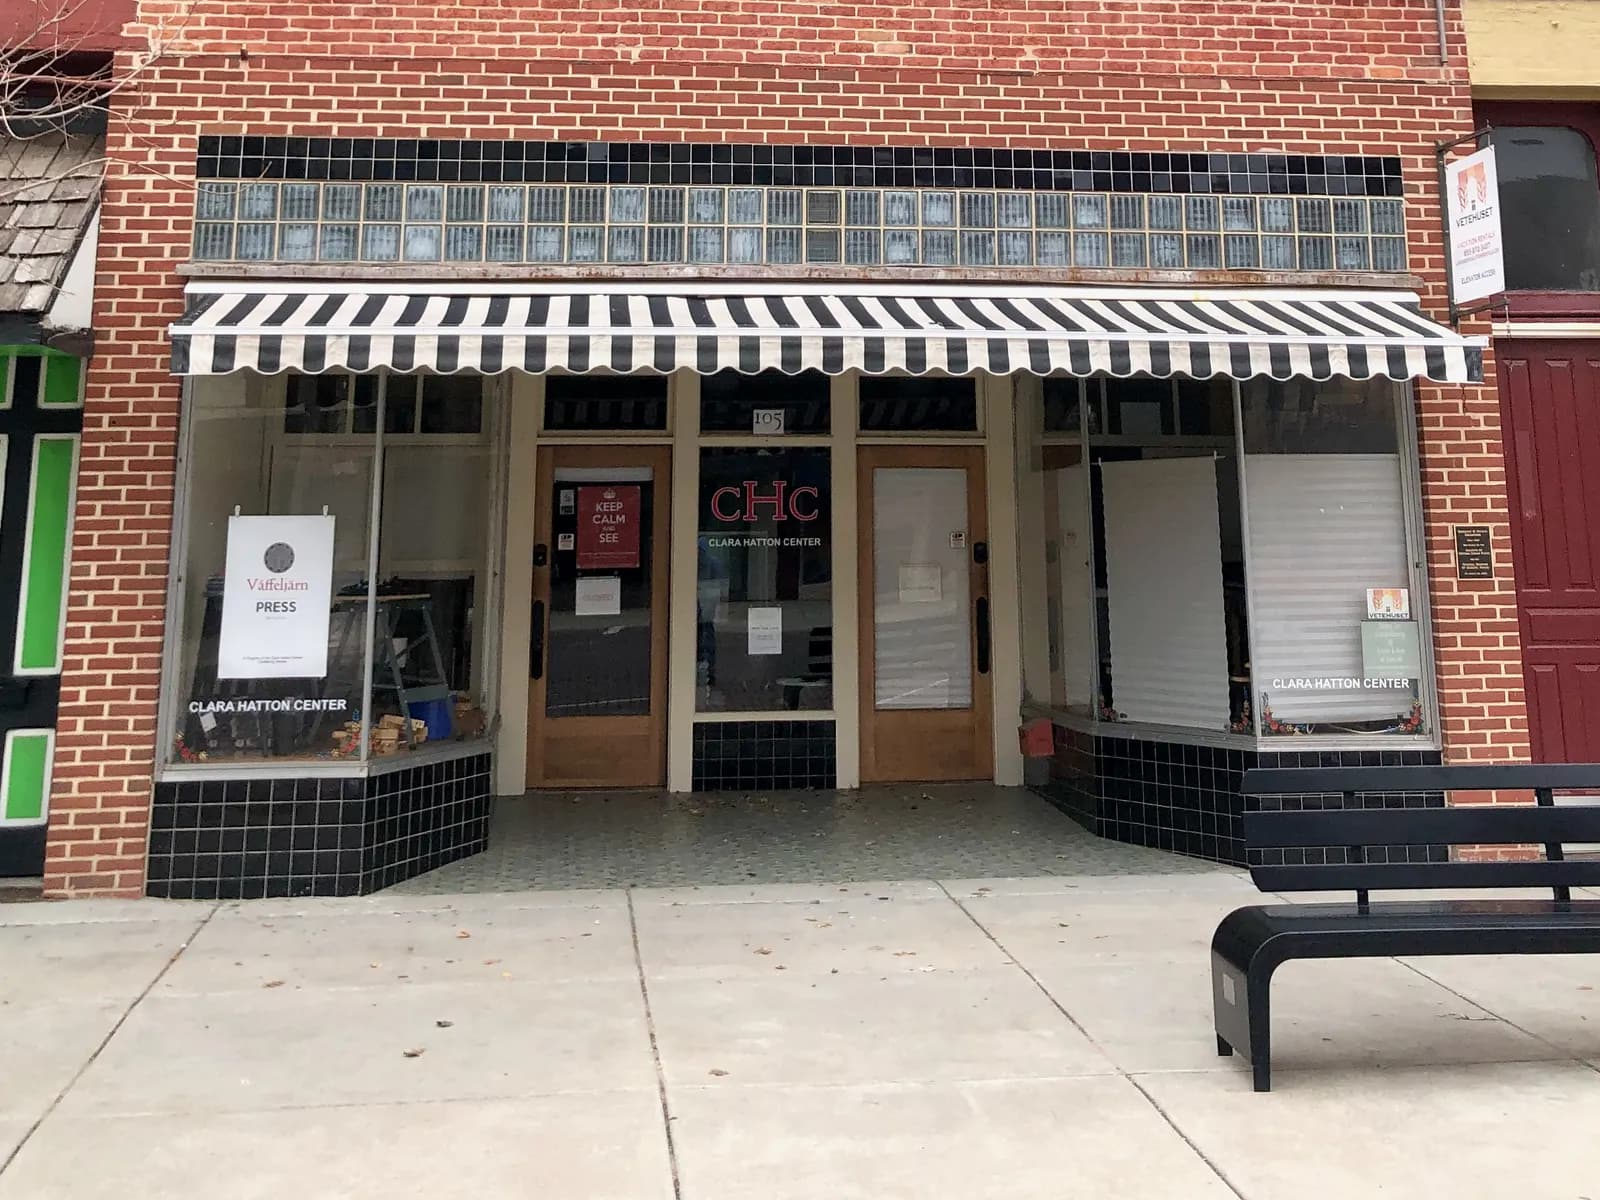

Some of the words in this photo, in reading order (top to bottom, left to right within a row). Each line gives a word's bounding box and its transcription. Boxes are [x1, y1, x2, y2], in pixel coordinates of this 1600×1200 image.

[1456, 207, 1493, 228] VETEHUSET
[755, 412, 783, 431] 105
[711, 480, 819, 521] CHC
[596, 502, 623, 512] KEEP
[592, 514, 625, 524] CALM
[600, 533, 619, 543] SEE
[708, 538, 741, 547] CLARA
[743, 538, 780, 546] HATTON
[783, 537, 821, 546] CENTER
[256, 601, 297, 613] PRESS
[1272, 678, 1312, 689] CLARA
[1315, 678, 1360, 689] HATTON
[1363, 678, 1409, 689] CENTER
[189, 701, 234, 712] CLARA
[238, 700, 290, 711] HATTON
[294, 699, 347, 711] CENTER
